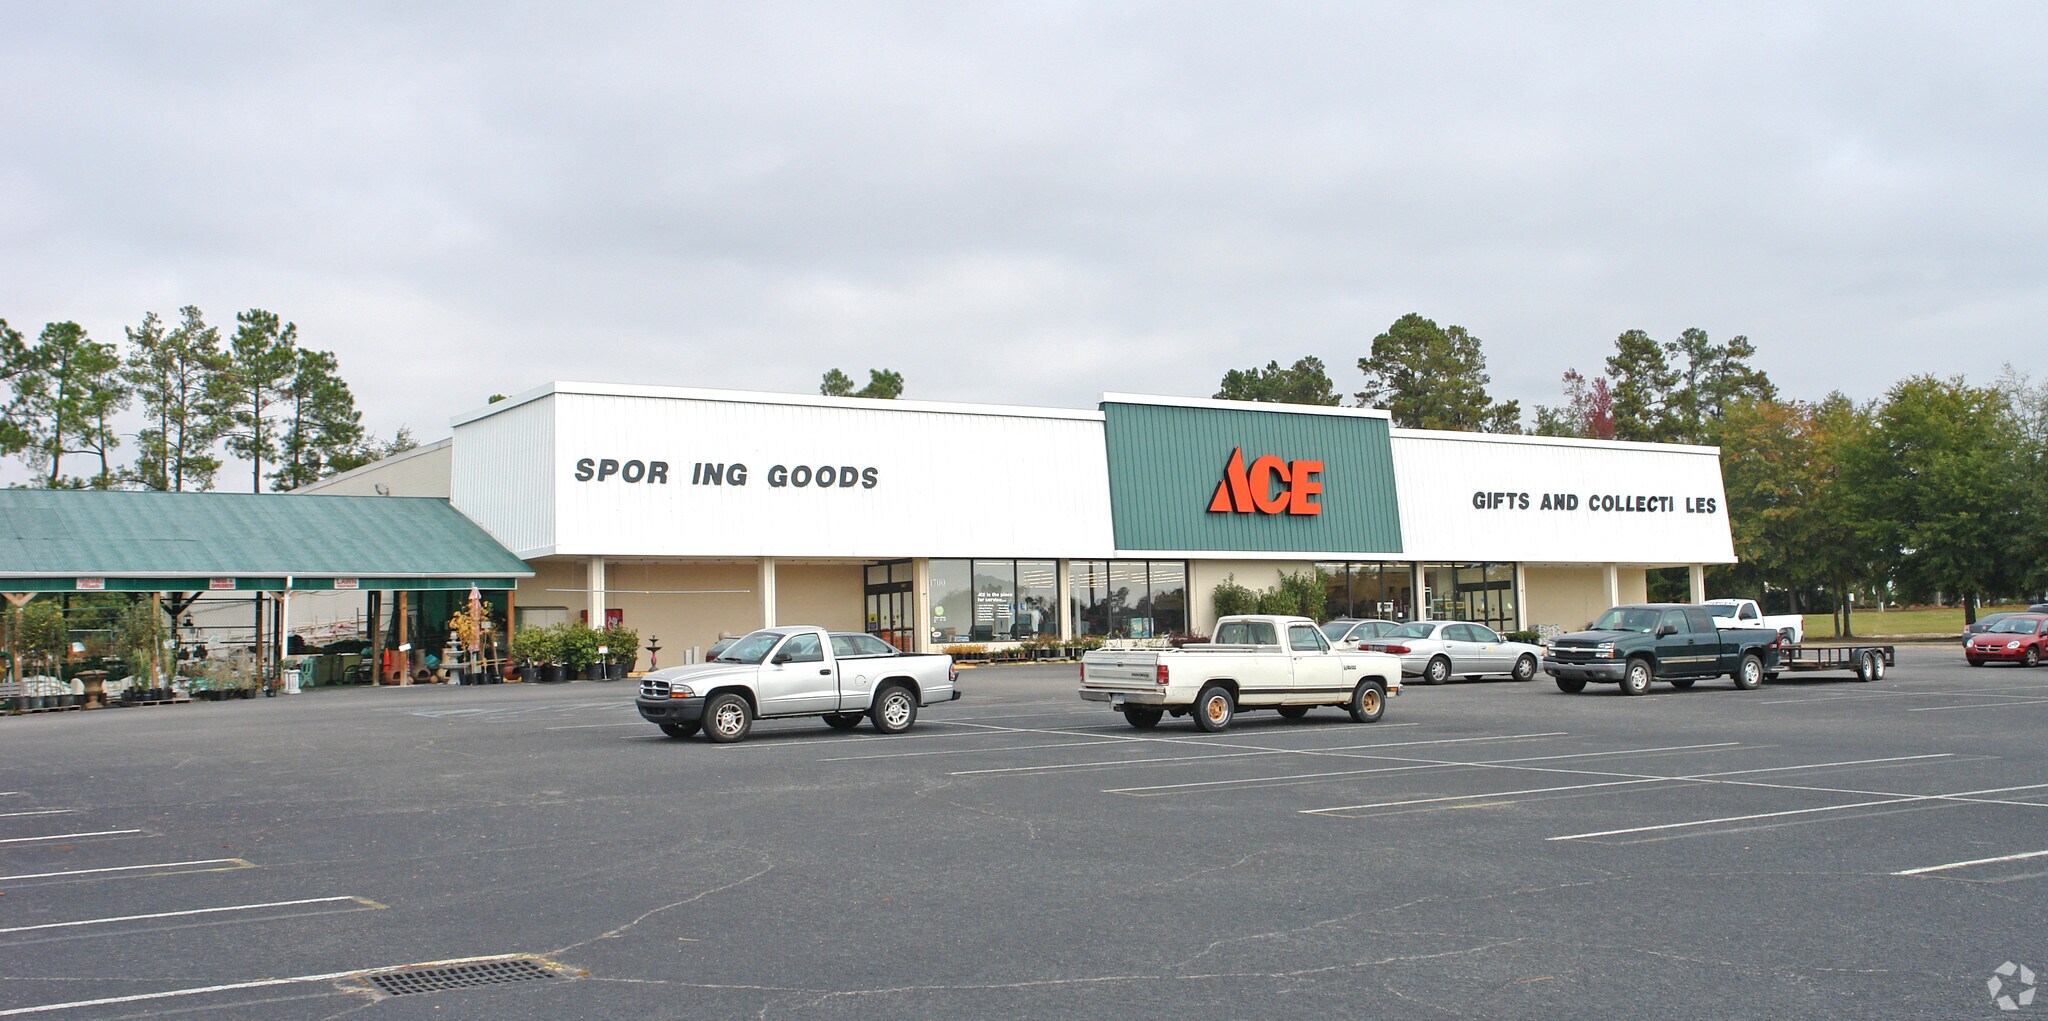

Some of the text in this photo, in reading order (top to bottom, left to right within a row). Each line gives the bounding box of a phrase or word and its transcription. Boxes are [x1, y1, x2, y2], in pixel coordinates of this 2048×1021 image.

[767, 464, 879, 489] GOODS
[1207, 446, 1324, 515] ACE
[1472, 491, 1530, 511] GIFTS
[1539, 493, 1579, 511] AND
